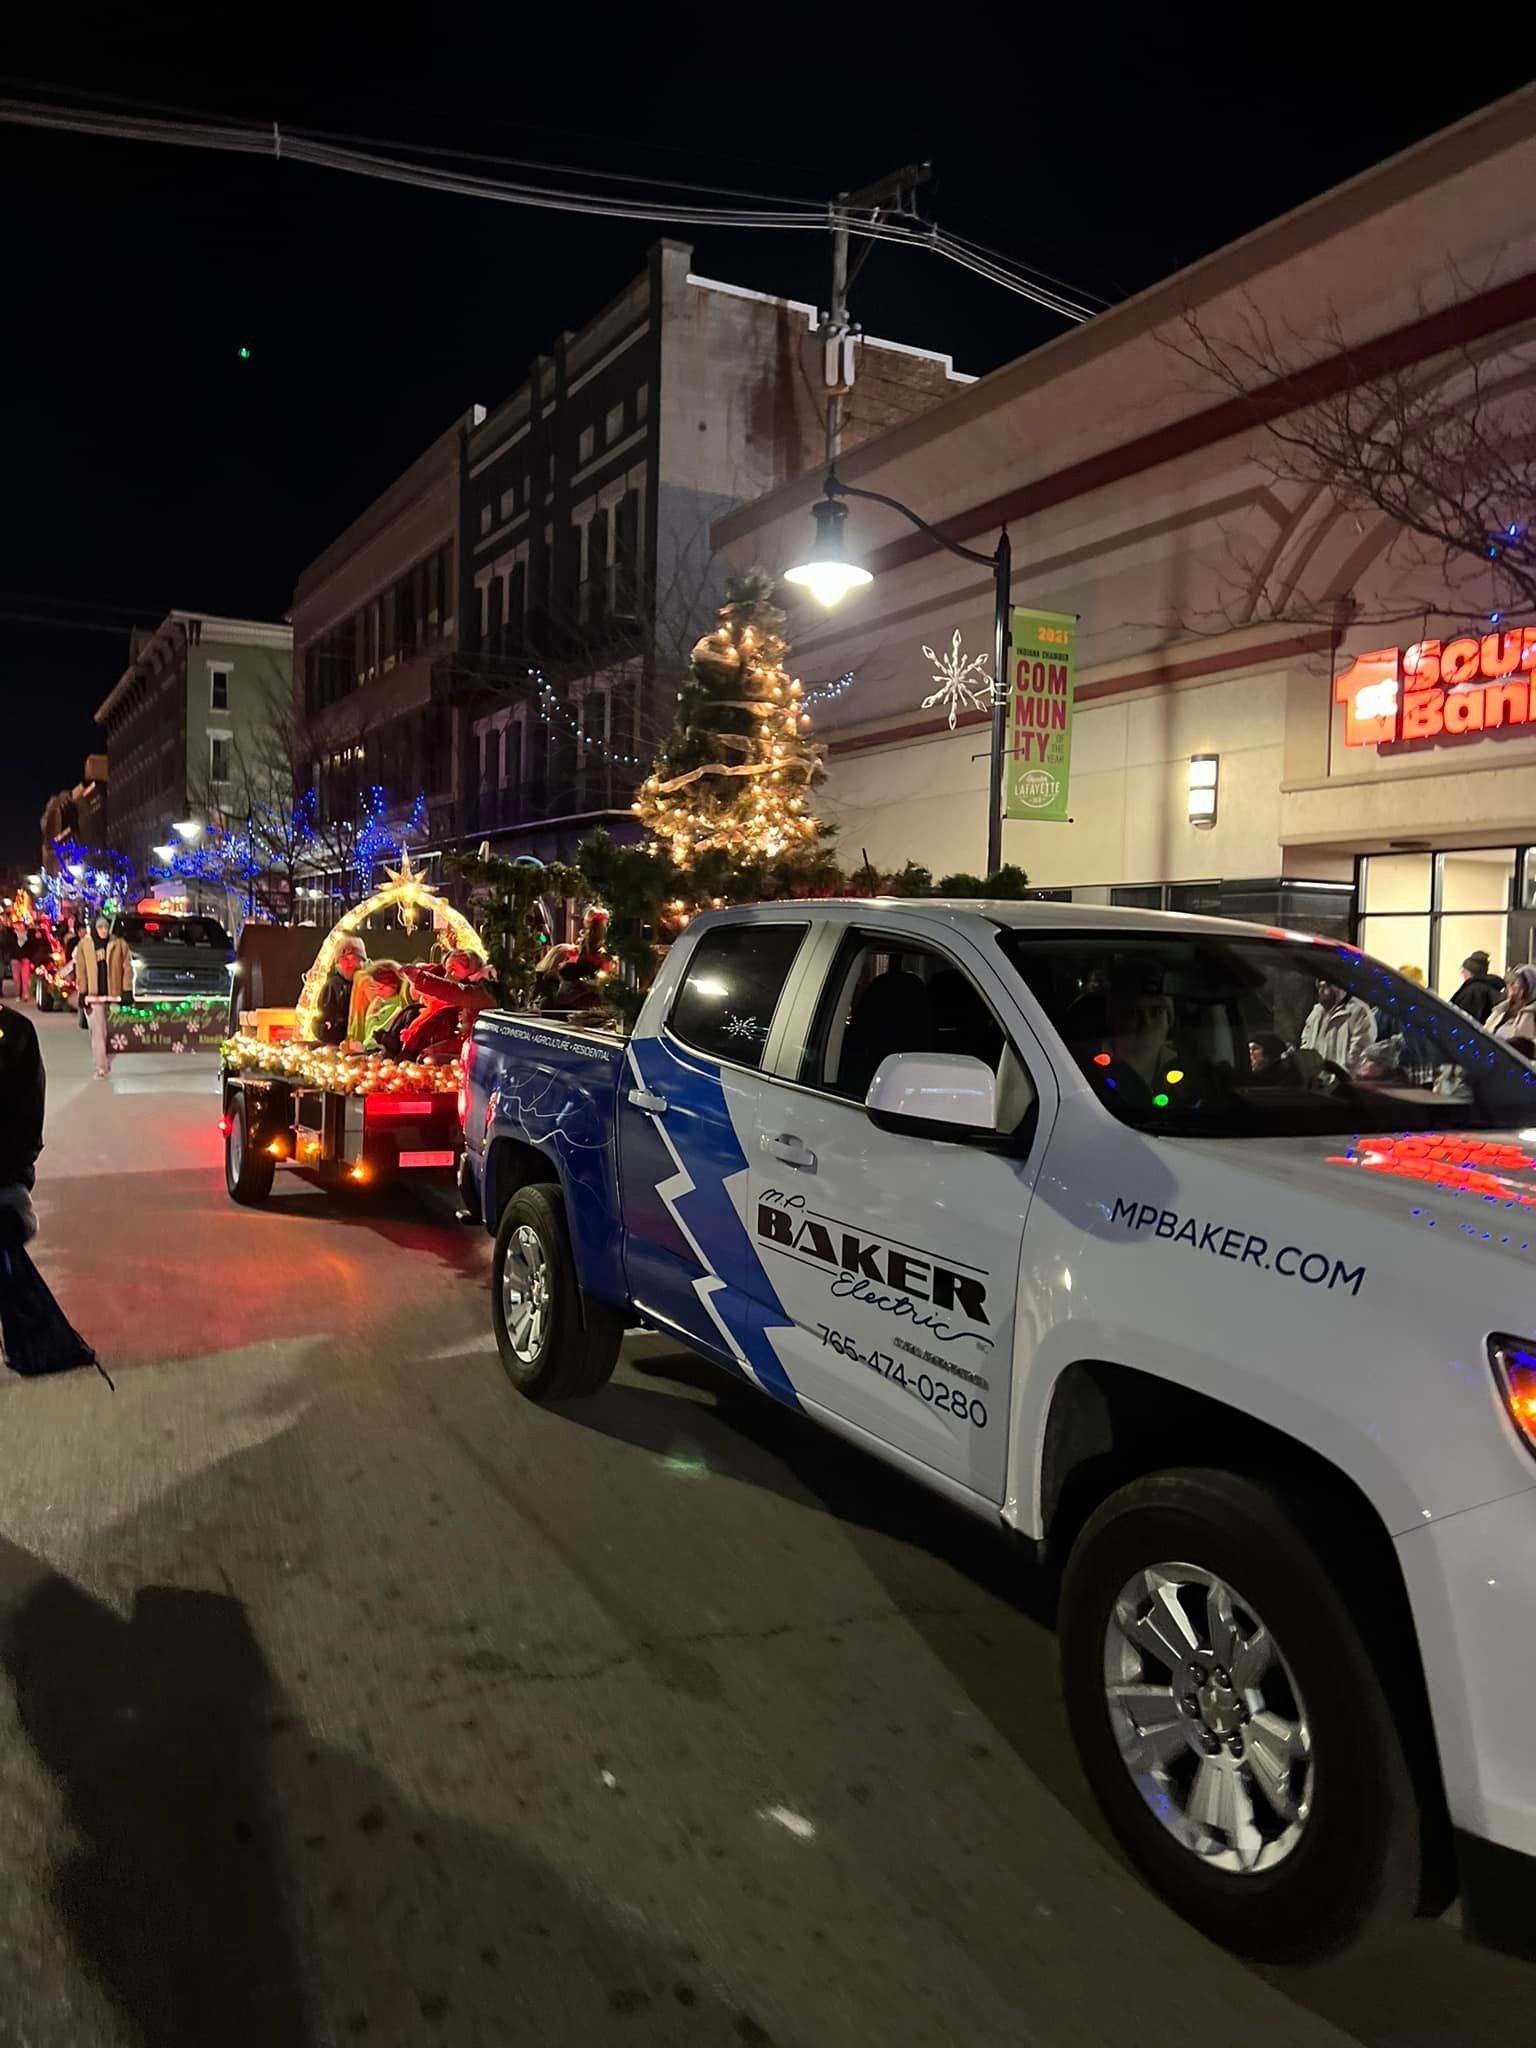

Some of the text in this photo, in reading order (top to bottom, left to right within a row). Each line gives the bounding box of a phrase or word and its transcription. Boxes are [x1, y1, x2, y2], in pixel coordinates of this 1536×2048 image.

[1016, 648, 1069, 661] INDIANA CHAMBER
[1016, 660, 1068, 695] COM
[1015, 695, 1067, 731] MUN
[1013, 730, 1050, 763] ITY
[1014, 781, 1060, 796] LAFAYETTE
[501, 1026, 531, 1041] COMMERCIAL
[534, 1034, 570, 1051] AGRICULTURE
[573, 1043, 610, 1062] RESIDENTIAL
[757, 1203, 991, 1326] BAKER
[1110, 1197, 1366, 1296] MPBAKER.COM
[830, 1271, 994, 1348] Electric
[817, 1322, 988, 1428] 765-474-0280
